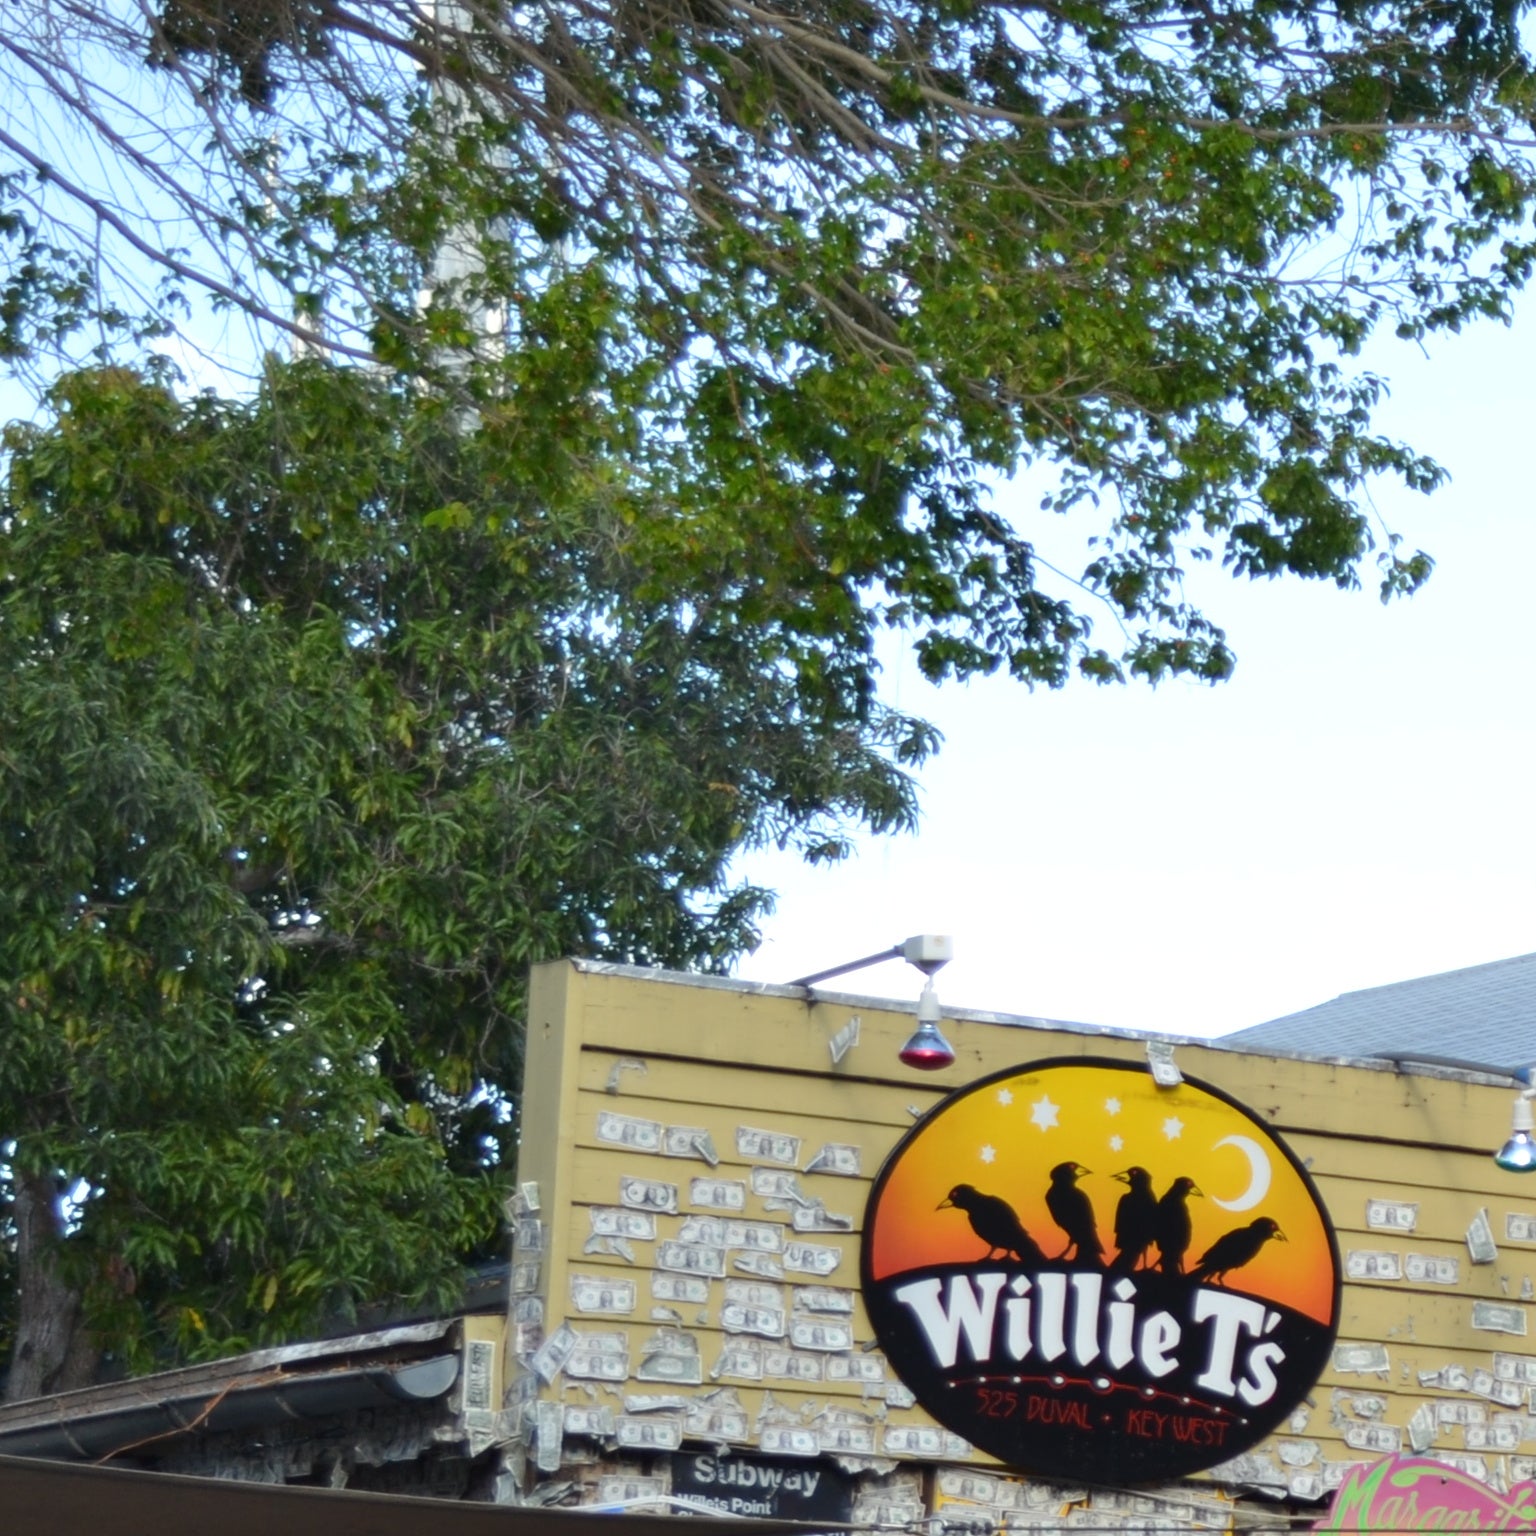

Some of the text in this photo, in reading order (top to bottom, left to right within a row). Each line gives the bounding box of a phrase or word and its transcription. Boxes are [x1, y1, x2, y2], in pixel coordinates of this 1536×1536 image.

[896, 1273, 1286, 1406] Willie T's
[976, 1388, 1230, 1446] 525 DUVAL KEY WEST
[694, 1455, 820, 1497] Subway
[732, 1498, 771, 1515] Point
